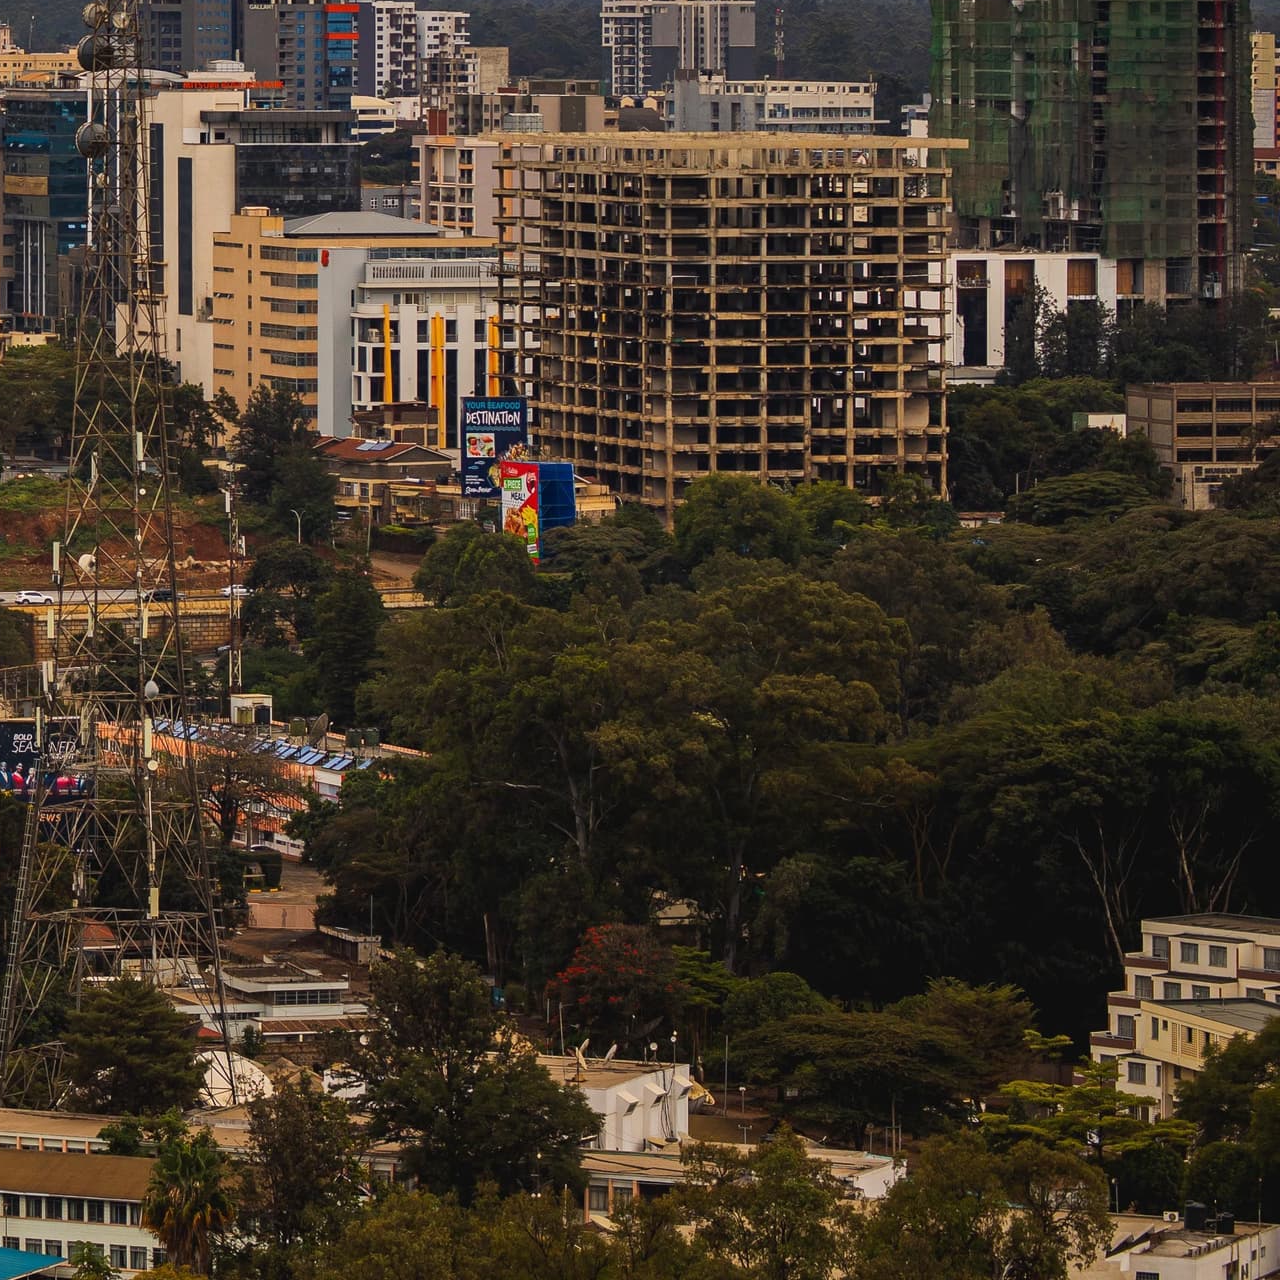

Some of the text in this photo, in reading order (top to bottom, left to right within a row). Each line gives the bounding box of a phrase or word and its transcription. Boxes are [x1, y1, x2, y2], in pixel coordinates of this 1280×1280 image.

[466, 401, 521, 410] YOUR SEAFOOD
[13, 733, 33, 741] BOLD
